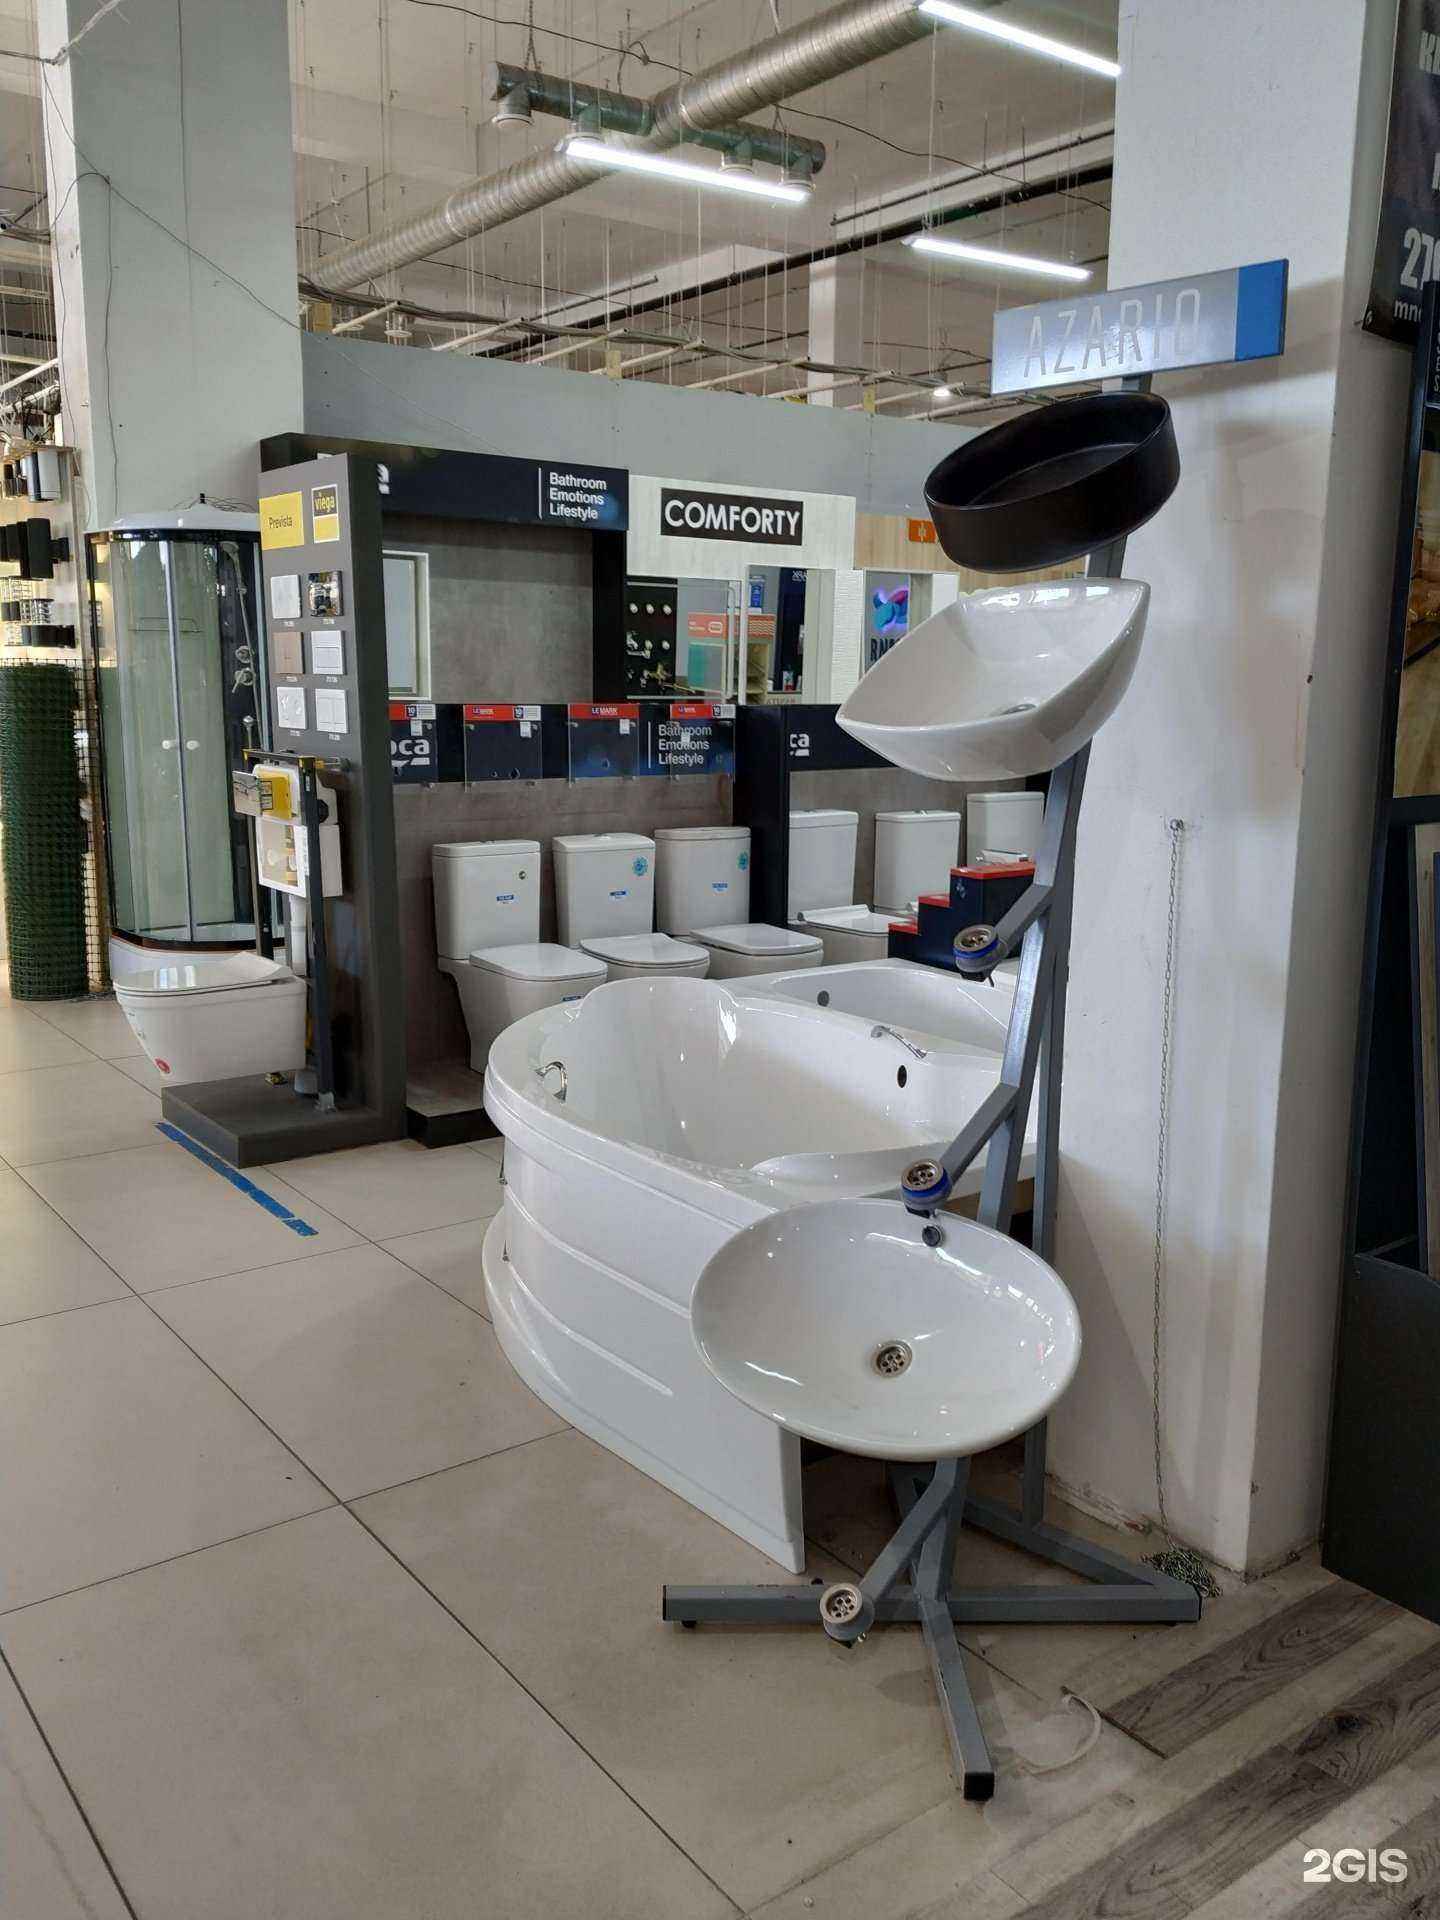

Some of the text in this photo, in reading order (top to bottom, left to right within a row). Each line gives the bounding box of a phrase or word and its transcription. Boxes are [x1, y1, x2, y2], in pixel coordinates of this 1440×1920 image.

[1023, 287, 1201, 377] AZARIO
[549, 472, 607, 490] Bathroom
[314, 491, 335, 513] viega
[549, 487, 605, 505] Emotions
[549, 502, 599, 522] Lifestyle
[664, 499, 800, 536] COMFORTY
[268, 515, 293, 529] Prevista
[658, 724, 712, 737] Bathroom
[658, 753, 704, 767] Lifestyle
